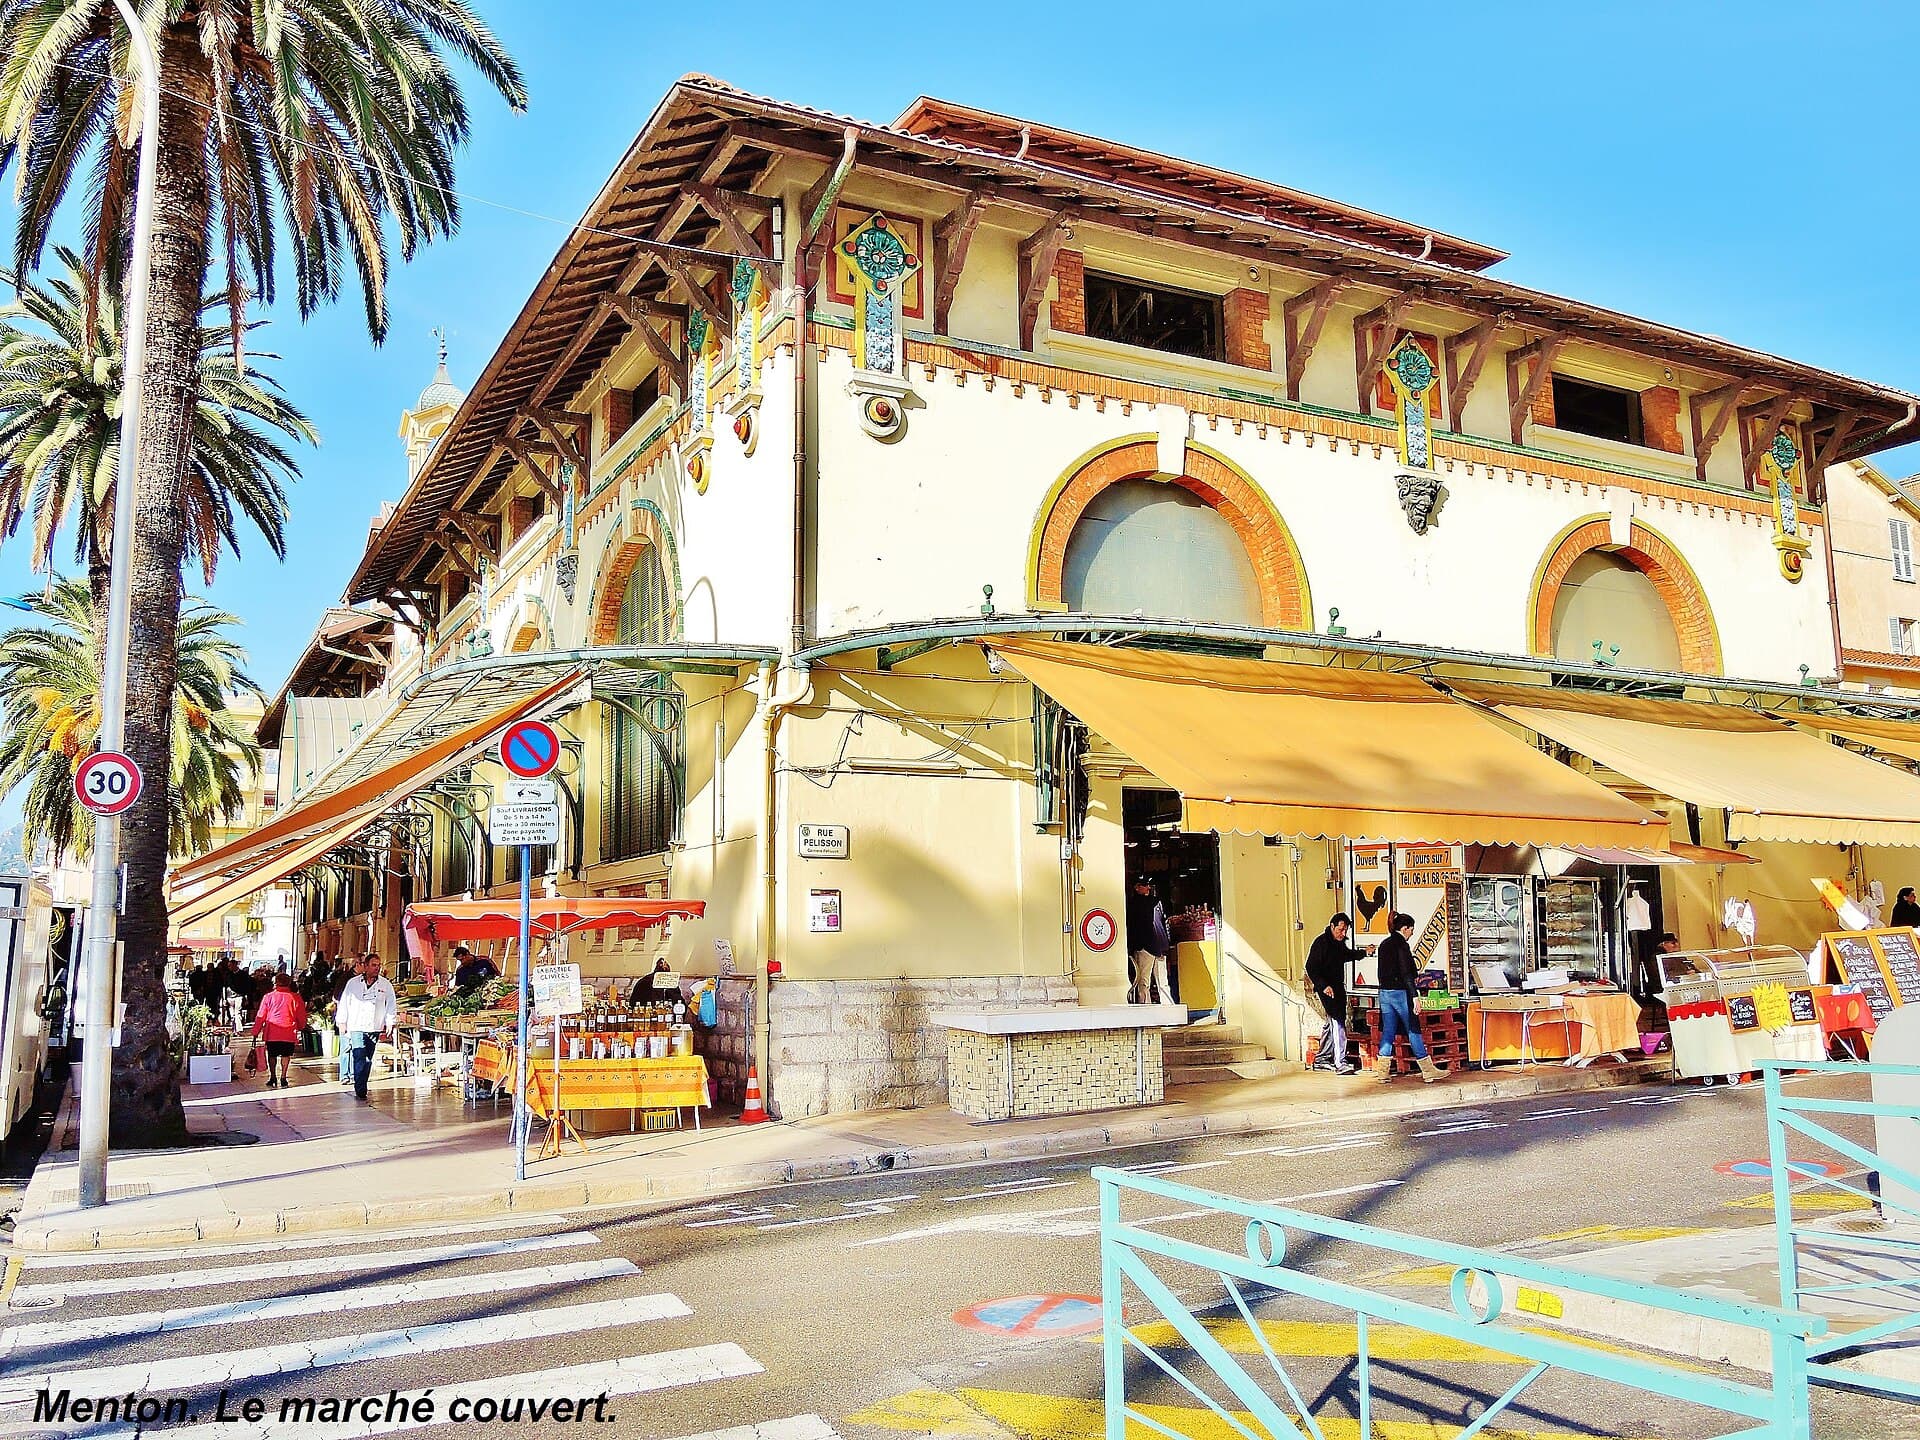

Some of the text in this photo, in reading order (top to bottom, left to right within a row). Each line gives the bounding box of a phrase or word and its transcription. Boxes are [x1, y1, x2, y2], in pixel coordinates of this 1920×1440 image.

[88, 770, 126, 795] 30
[817, 828, 833, 837] RUE
[803, 838, 842, 848] PELISSON
[1355, 853, 1378, 867] Ouvert
[1406, 850, 1449, 867] 7 jours sur 7
[1412, 872, 1421, 885] 06
[1422, 872, 1430, 885] 41
[1431, 871, 1440, 884] 68
